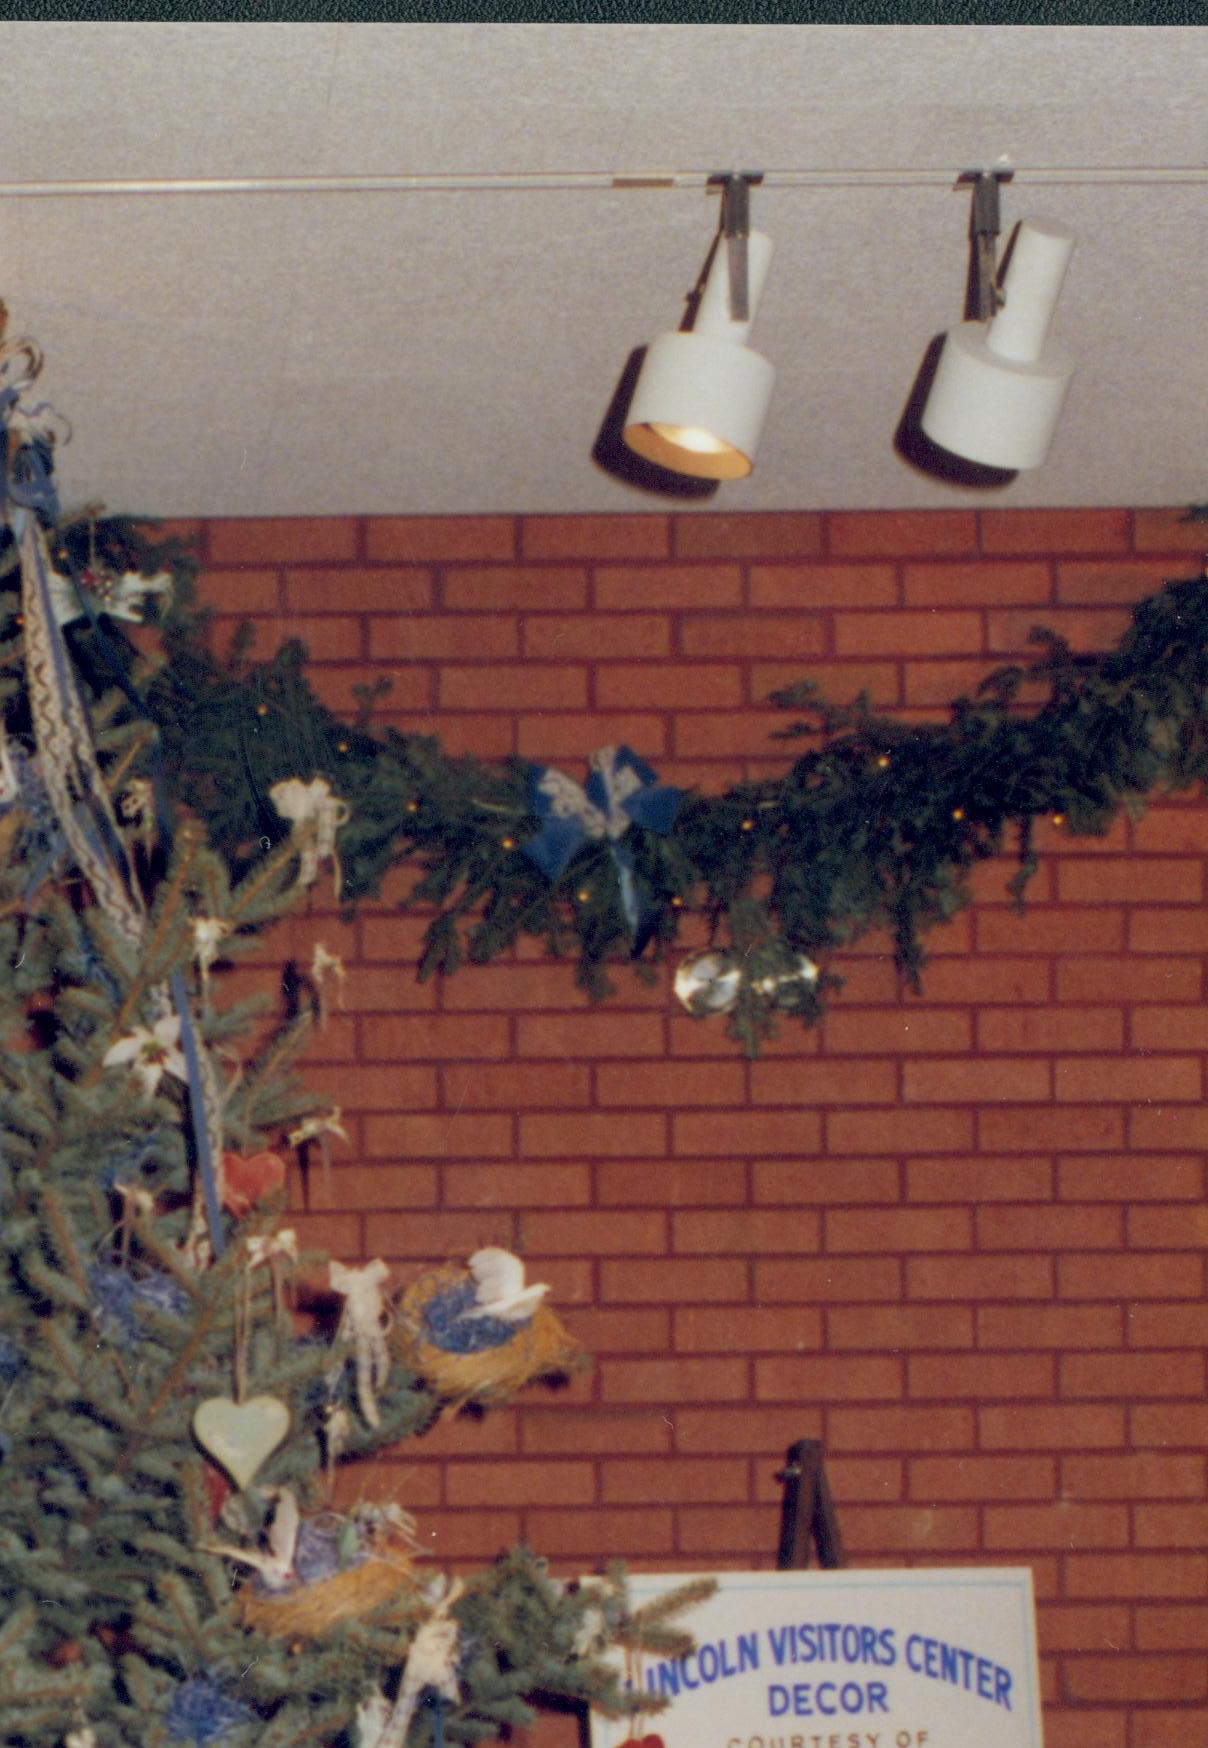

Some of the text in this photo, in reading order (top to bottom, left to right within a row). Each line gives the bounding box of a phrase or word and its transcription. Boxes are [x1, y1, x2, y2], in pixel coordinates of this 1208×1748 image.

[627, 1623, 1014, 1711] INCOLN VISITORS CENTER
[768, 1682, 890, 1716] DECOR
[897, 1731, 931, 1748] OF
